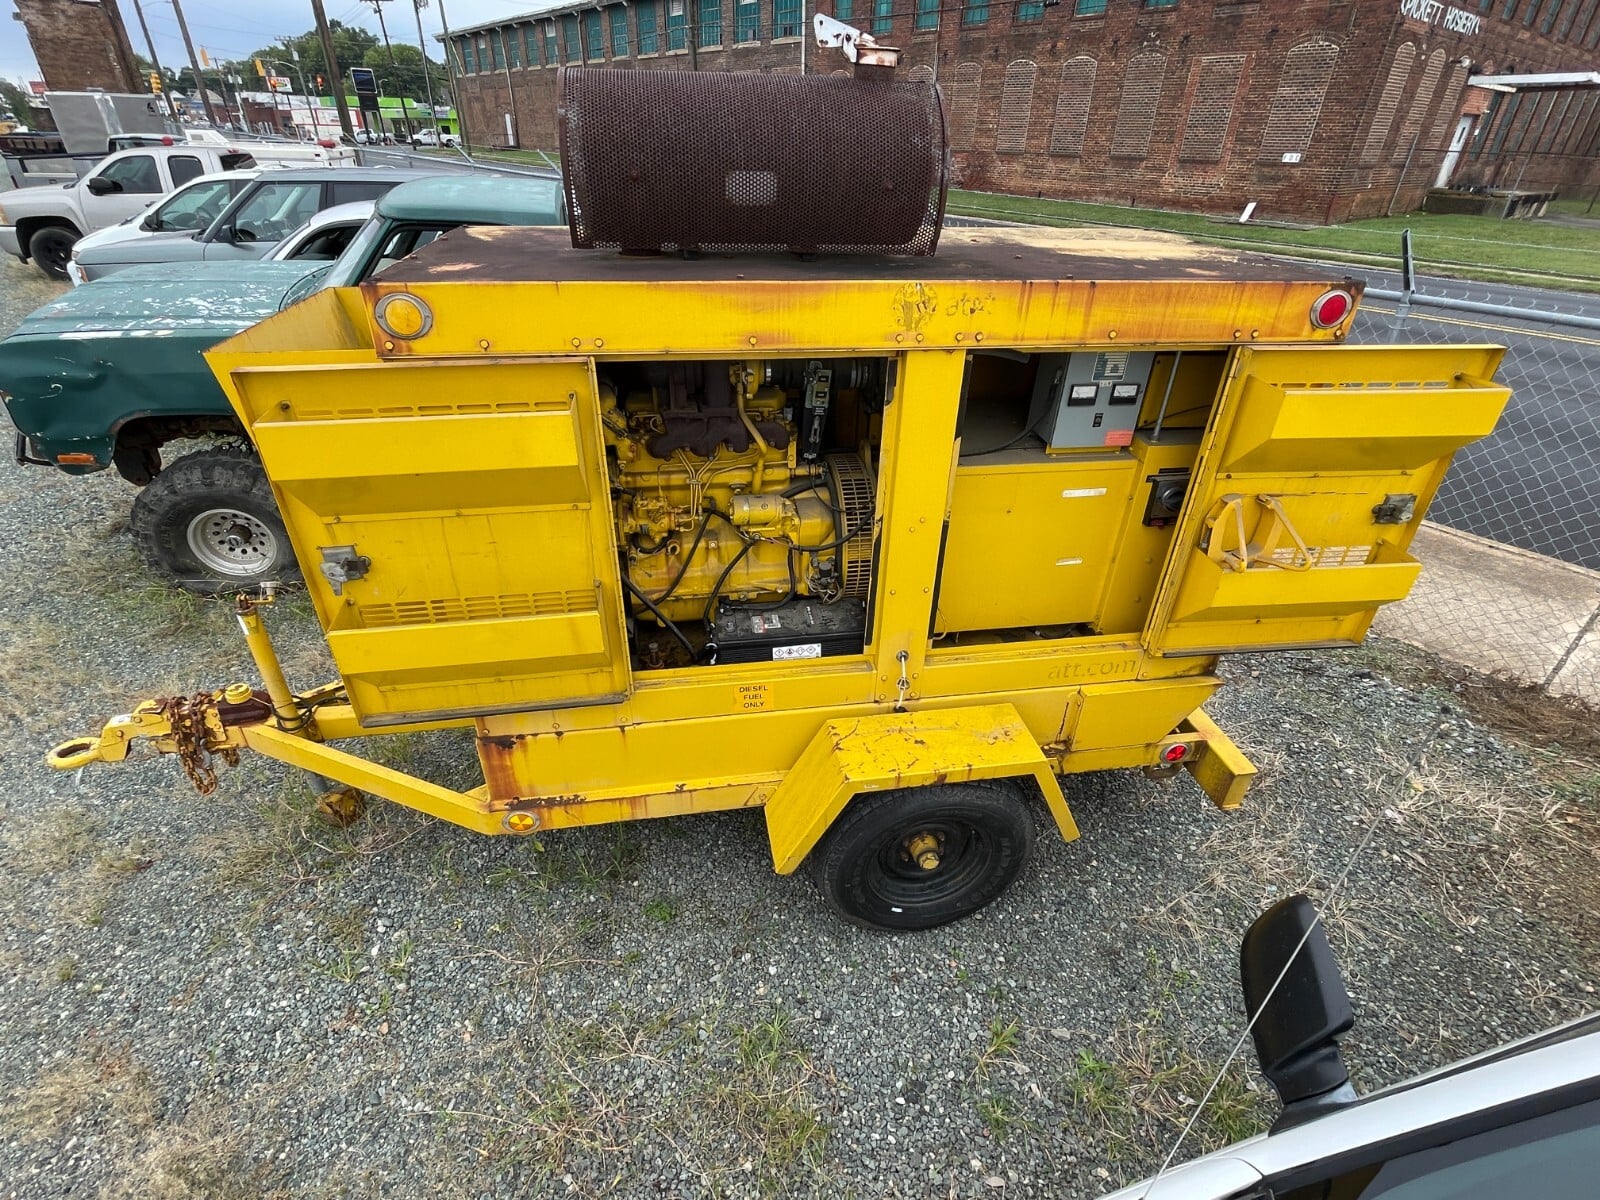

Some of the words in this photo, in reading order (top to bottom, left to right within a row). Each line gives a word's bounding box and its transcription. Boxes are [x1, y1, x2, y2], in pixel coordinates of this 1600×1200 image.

[1047, 659, 1136, 680] att.com
[739, 684, 768, 693] DIESEL
[743, 693, 763, 701] FUEL
[743, 701, 765, 709] ONLY
